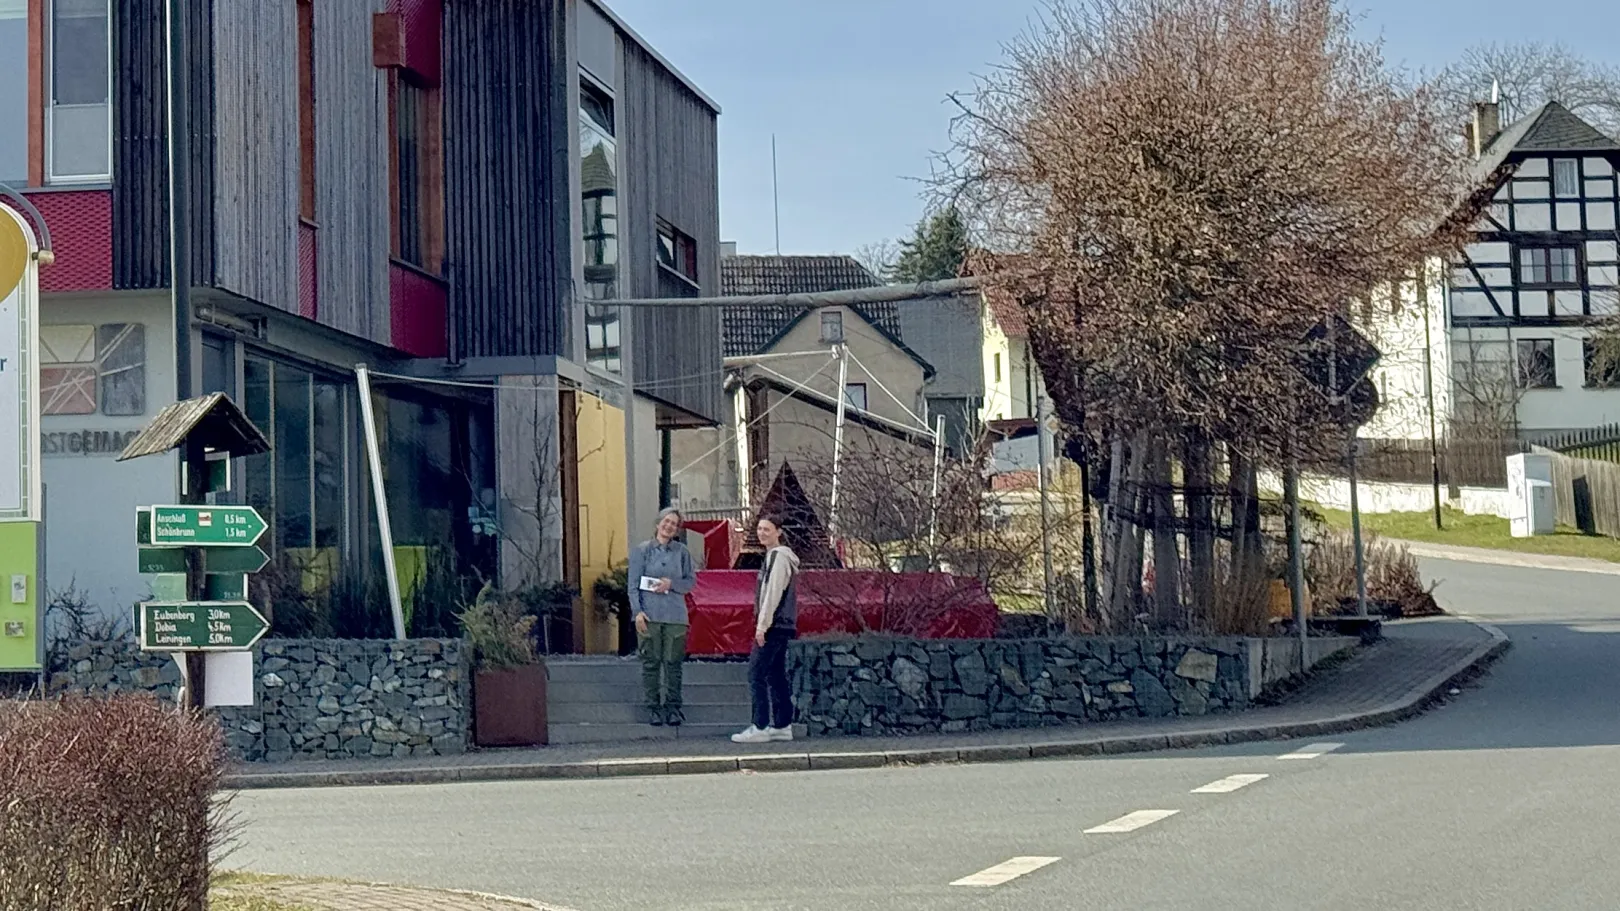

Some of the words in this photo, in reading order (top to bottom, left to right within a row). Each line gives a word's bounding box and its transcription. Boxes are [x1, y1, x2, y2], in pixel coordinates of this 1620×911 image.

[236, 514, 247, 524] km
[225, 527, 235, 538] 1,5
[236, 527, 247, 538] km
[153, 609, 195, 623] Eubenberg
[156, 633, 192, 646] Leiningen
